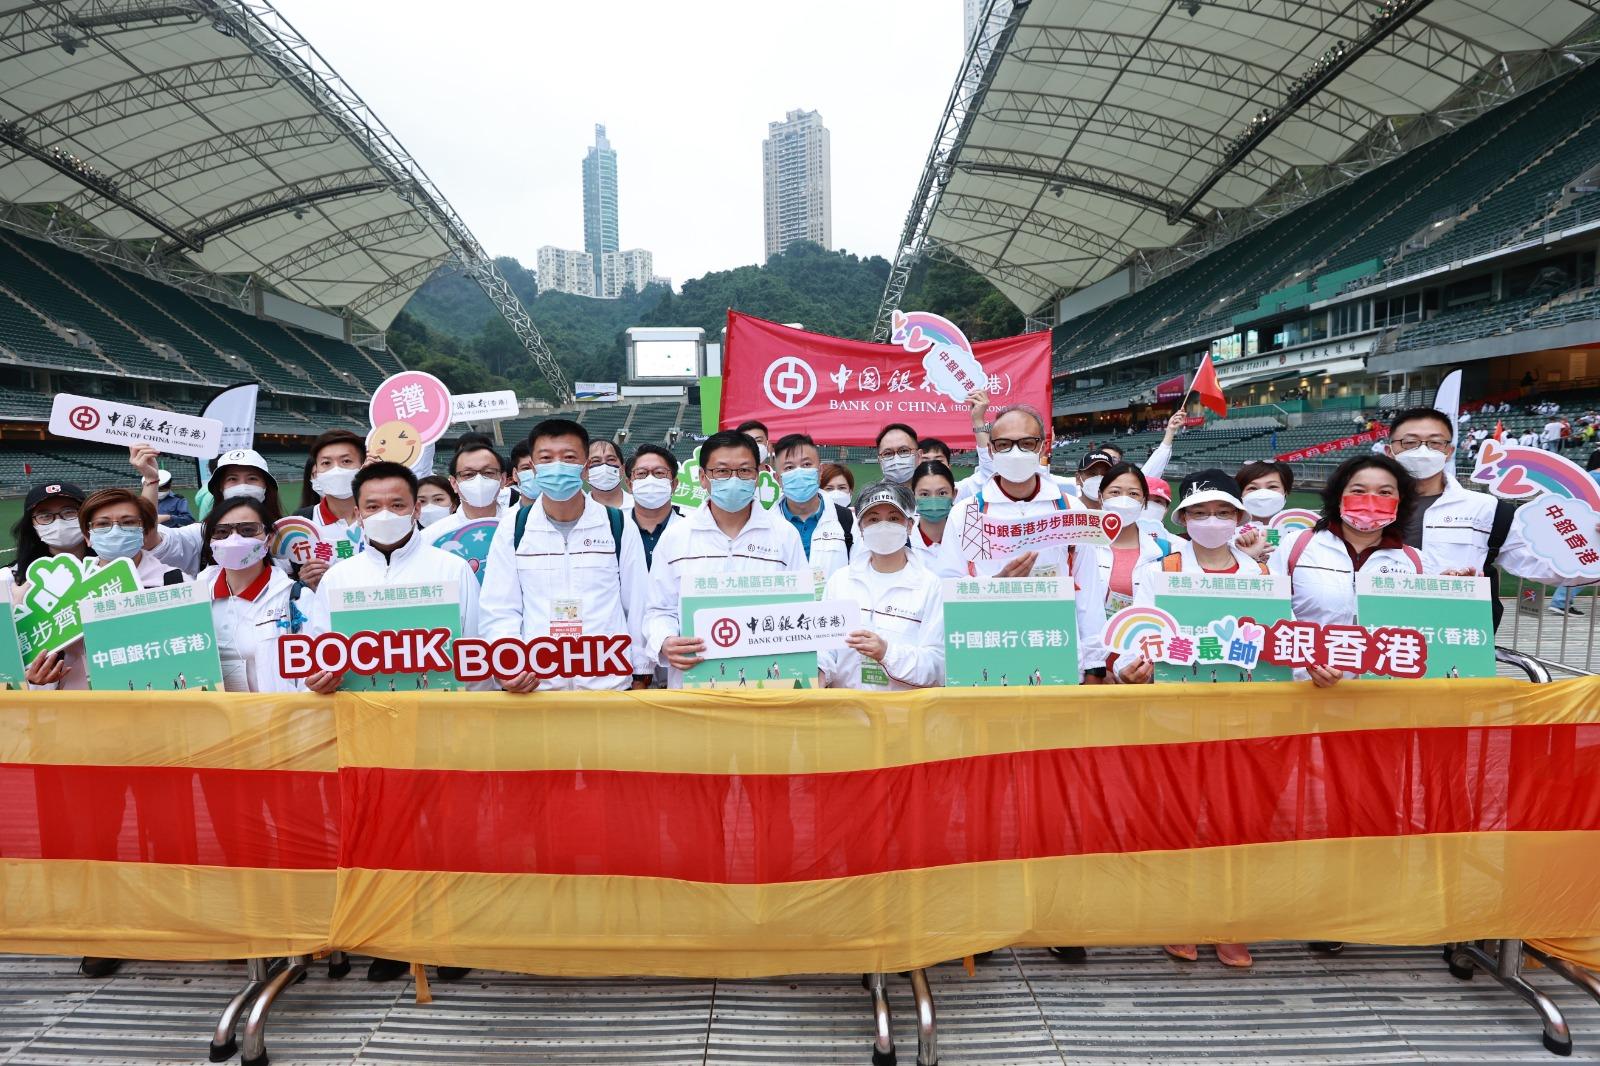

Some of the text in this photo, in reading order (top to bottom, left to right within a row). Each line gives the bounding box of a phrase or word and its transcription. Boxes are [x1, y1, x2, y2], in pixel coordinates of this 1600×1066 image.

[939, 351, 976, 392] 中銀香港
[390, 383, 429, 420] 讚
[829, 399, 870, 411] BANK
[874, 401, 893, 411] OF
[897, 401, 948, 413] CHINA
[105, 428, 129, 438] BANK
[143, 435, 170, 444] CHINA
[1545, 504, 1600, 566] 中銀香港
[284, 633, 447, 674] BOCHK
[459, 639, 629, 676] BOCHK
[748, 635, 771, 645] BANK
[772, 634, 784, 643] OF
[785, 633, 812, 642] CHINA
[1139, 635, 1258, 665] 行善最帥
[1273, 624, 1421, 673] 銀香港
